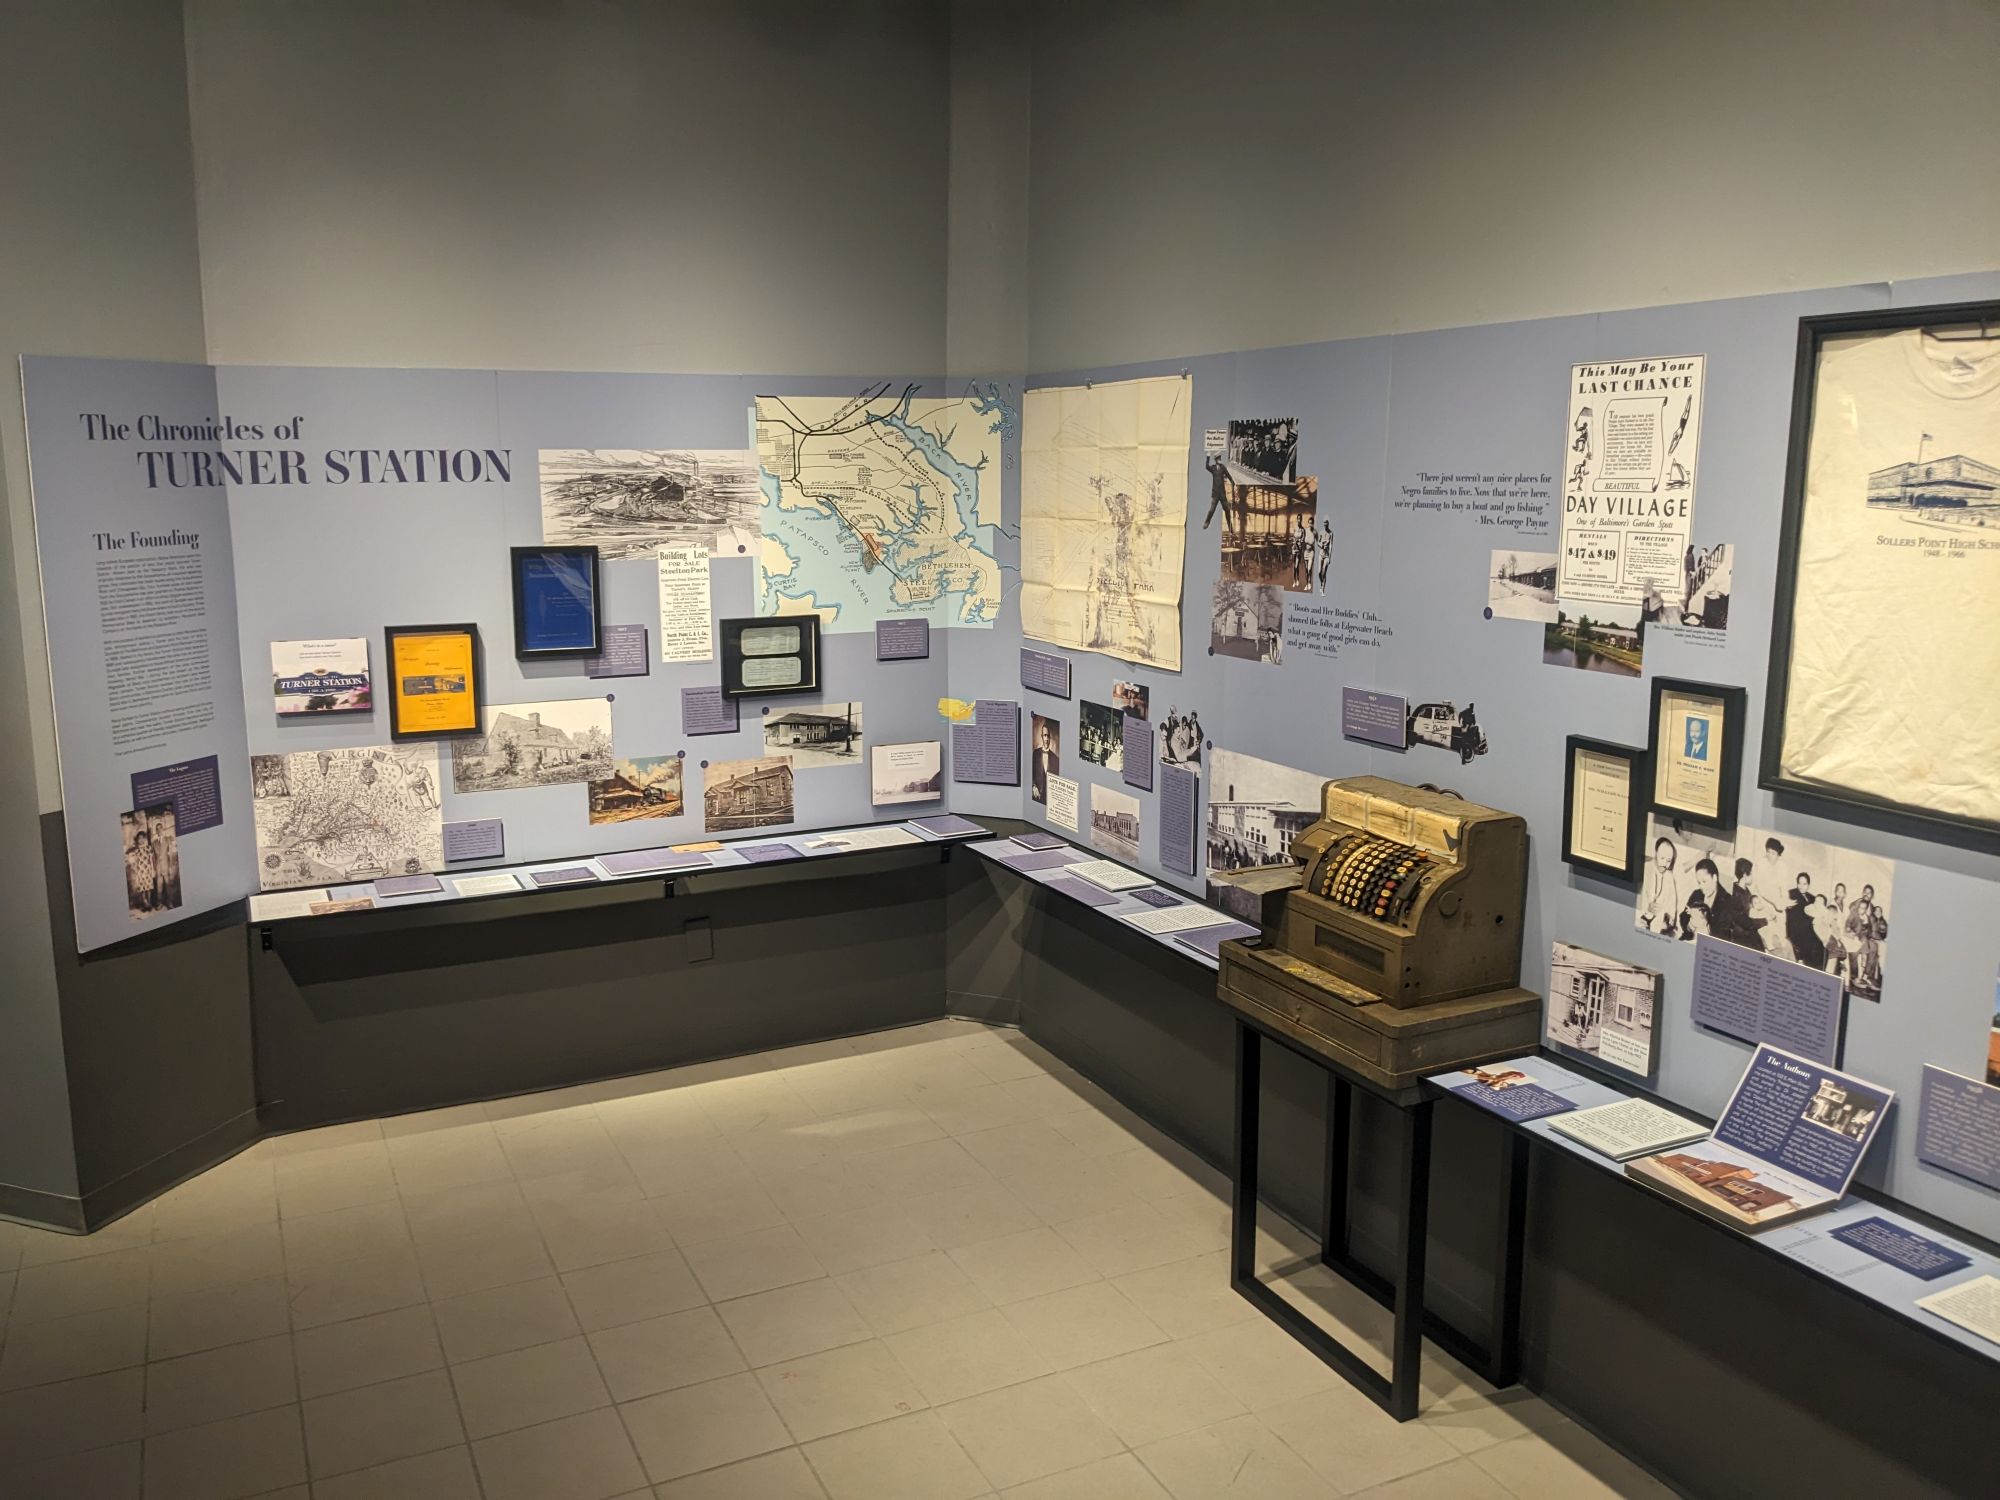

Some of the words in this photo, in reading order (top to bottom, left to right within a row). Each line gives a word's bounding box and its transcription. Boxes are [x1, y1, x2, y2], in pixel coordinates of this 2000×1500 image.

[1579, 366, 1606, 378] This
[1608, 364, 1636, 377] May
[1639, 362, 1656, 374] Be
[1660, 360, 1694, 372] Your
[1578, 380, 1619, 394] LAST
[1623, 376, 1693, 392] CHANCE
[80, 413, 130, 441] The
[137, 414, 264, 442] Chronicles
[273, 415, 304, 441] of
[137, 449, 311, 489] TURNER
[324, 449, 512, 484] STATION
[1440, 472, 1453, 484] just
[1455, 472, 1481, 483] weren't
[1482, 475, 1494, 486] any
[1497, 473, 1513, 483] nice
[1514, 472, 1539, 486] places
[1540, 473, 1552, 484] for
[1604, 482, 1640, 490] BEAUTIFUL
[956, 472, 972, 501] RIVER
[1400, 486, 1421, 498] Negro
[1422, 486, 1448, 496] families
[1449, 487, 1457, 496] to
[1474, 486, 1490, 497] Now
[1492, 487, 1507, 497] that
[1508, 487, 1529, 498] we're
[1394, 499, 1411, 508] we're
[1412, 500, 1442, 512] planning
[1443, 501, 1450, 509] to
[1451, 500, 1465, 513] buy
[1472, 500, 1488, 511] boat
[1489, 501, 1504, 512] and
[1505, 504, 1515, 515] go
[1566, 495, 1598, 514] DAY
[1606, 497, 1688, 517] VILLAGE
[1496, 516, 1524, 529] George
[1525, 517, 1549, 530] Payne
[1576, 517, 1588, 525] One
[1589, 516, 1597, 528] of
[1599, 517, 1630, 527] Baltimore's
[1632, 519, 1656, 528] Garden
[1658, 520, 1673, 531] Spots
[92, 533, 125, 550] The
[130, 528, 200, 550] Founding
[781, 519, 829, 556] PATAPSCO
[1918, 537, 1948, 548] POINT
[1949, 538, 1976, 549] HIGH
[1977, 539, 2000, 549] SCH
[659, 551, 687, 561] Building
[693, 550, 708, 559] Lots
[1568, 547, 1587, 559] $47
[1588, 550, 1595, 559] &
[1597, 549, 1616, 561] $49
[660, 567, 690, 575] Steelton
[690, 566, 708, 574] Park
[921, 562, 971, 570] BETHLEHEM
[773, 578, 797, 587] CURTIS
[903, 579, 933, 587] STEEL
[851, 579, 869, 605] RIVER
[1310, 606, 1322, 614] and
[1288, 614, 1309, 625] showed
[1309, 616, 1319, 626] the
[1319, 618, 1333, 628] folks
[1334, 621, 1340, 629] at
[1341, 621, 1373, 634] Edgewater
[1374, 625, 1393, 636] Beach
[1287, 627, 1301, 636] what
[1306, 631, 1321, 641] gang
[1321, 631, 1329, 639] of
[1328, 633, 1343, 643] good
[1344, 634, 1358, 645] girls
[1286, 638, 1298, 647] and
[1298, 641, 1307, 650] get
[279, 680, 320, 690] TURNER
[322, 677, 363, 687] STATION
[1767, 1055, 1781, 1066] The
[1783, 1062, 1811, 1080] Anthony
